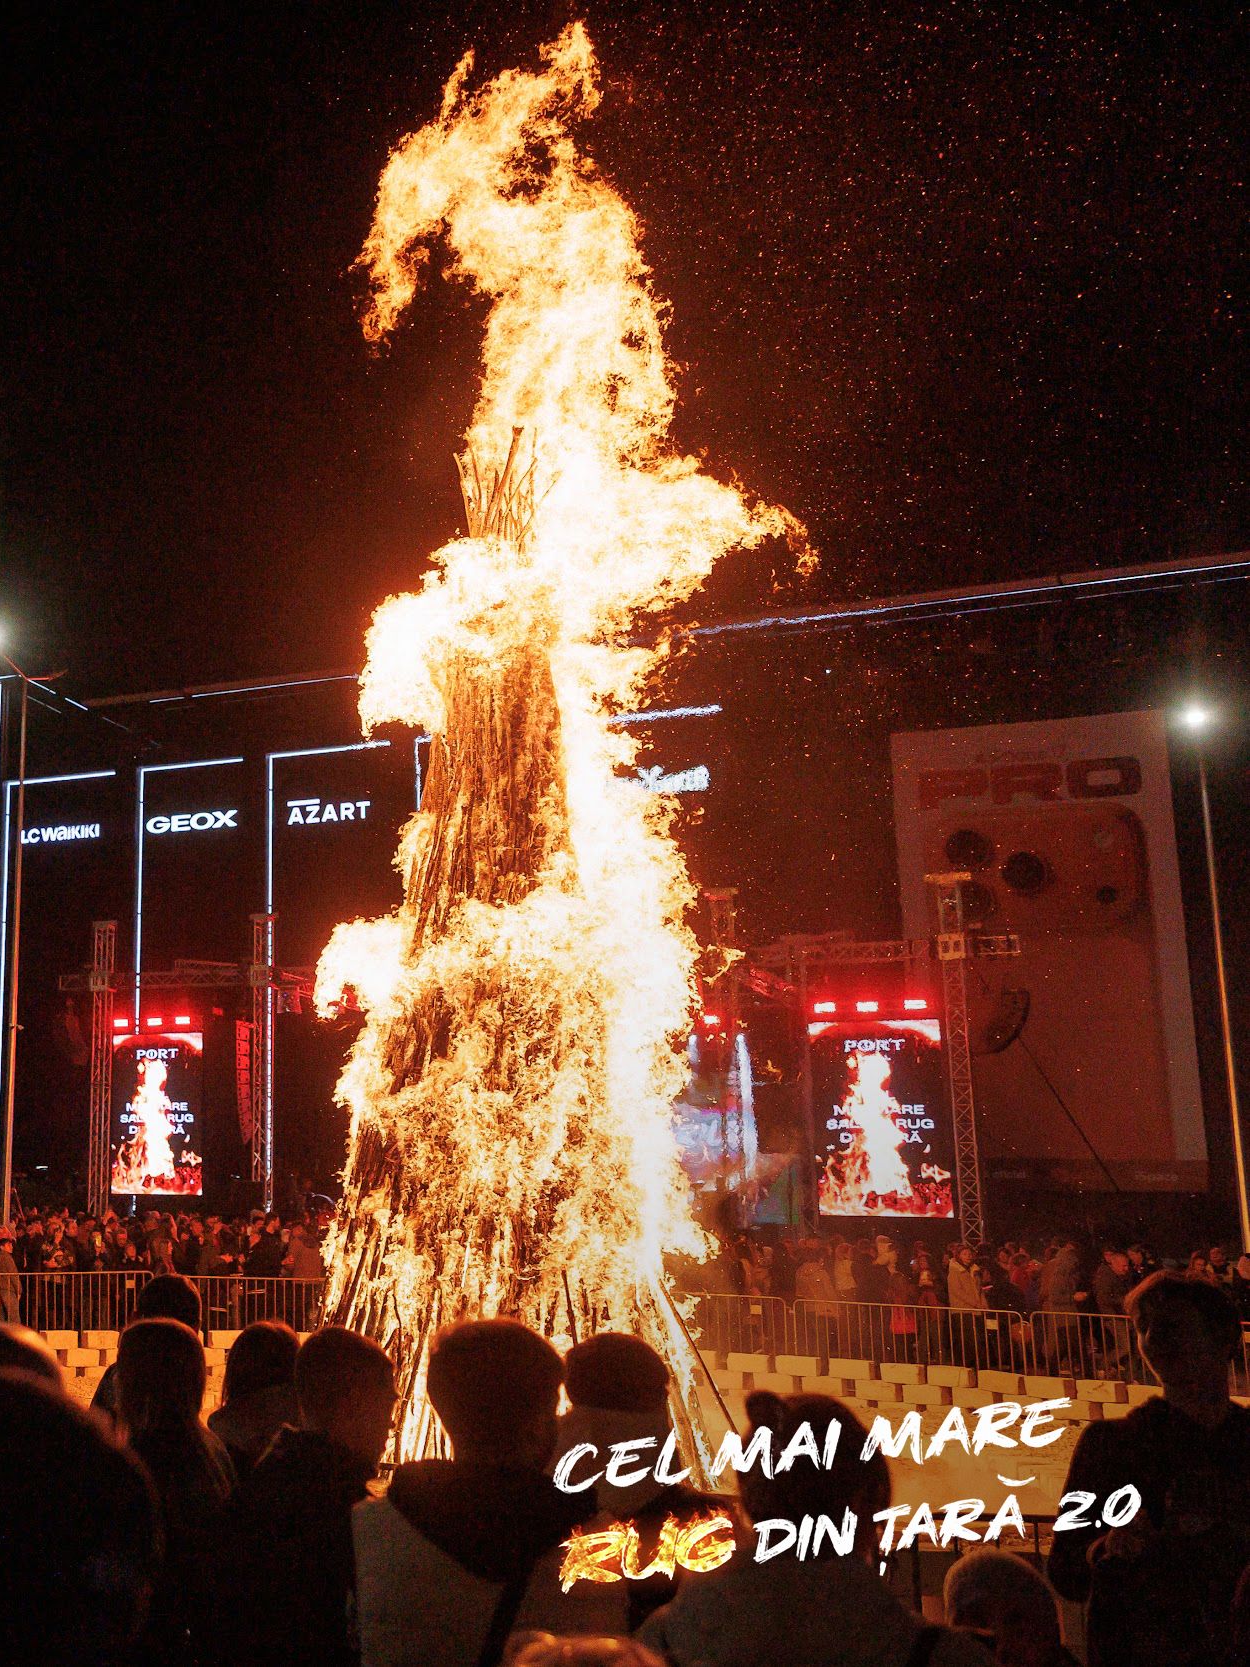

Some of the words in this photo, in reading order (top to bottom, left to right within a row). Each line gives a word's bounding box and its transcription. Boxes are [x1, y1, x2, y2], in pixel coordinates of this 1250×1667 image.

[918, 756, 1142, 811] PRO
[286, 798, 371, 826] AZART
[145, 808, 238, 835] GEOX
[843, 1038, 906, 1053] PORT
[135, 1047, 179, 1060] PORT
[166, 1113, 195, 1123] RUG
[894, 1117, 935, 1130] RUG
